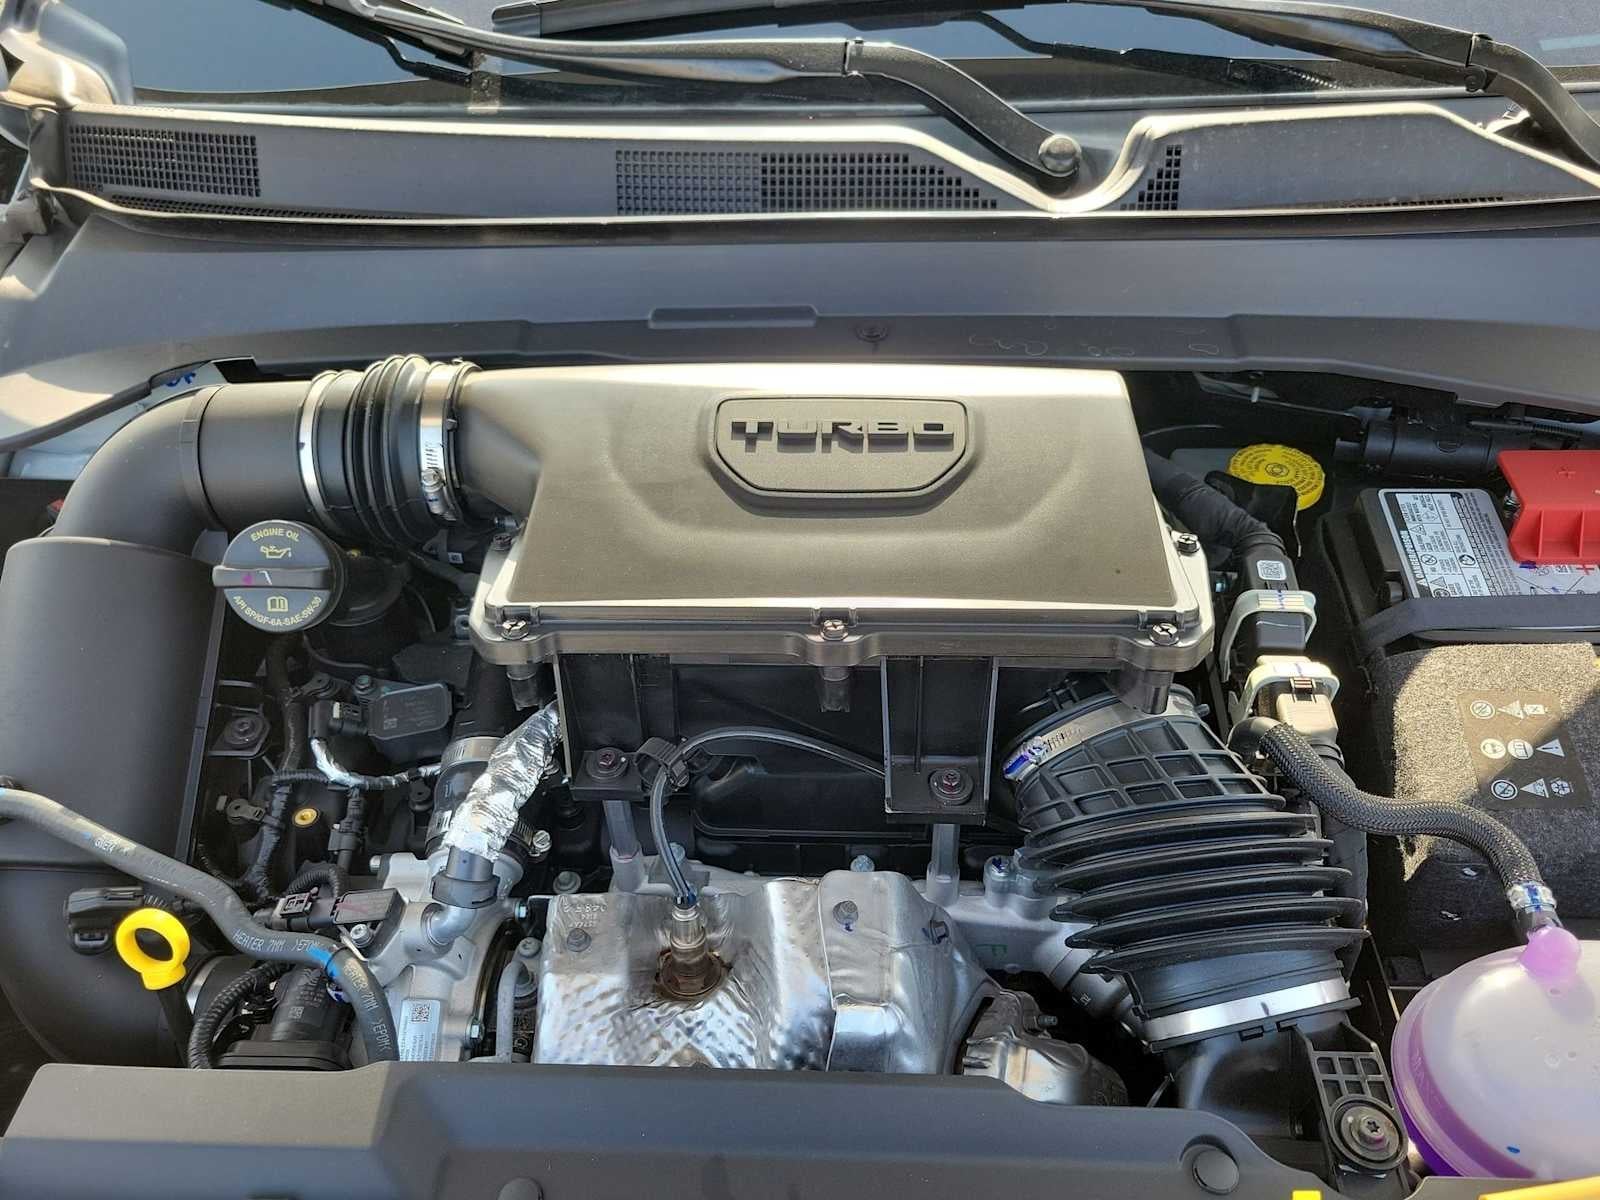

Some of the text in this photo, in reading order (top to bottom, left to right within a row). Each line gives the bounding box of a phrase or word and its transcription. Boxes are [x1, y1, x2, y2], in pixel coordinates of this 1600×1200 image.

[731, 419, 955, 453] TURBO
[250, 527, 300, 542] ENGINE OIL
[233, 595, 247, 610] API
[232, 927, 264, 951] HEATER
